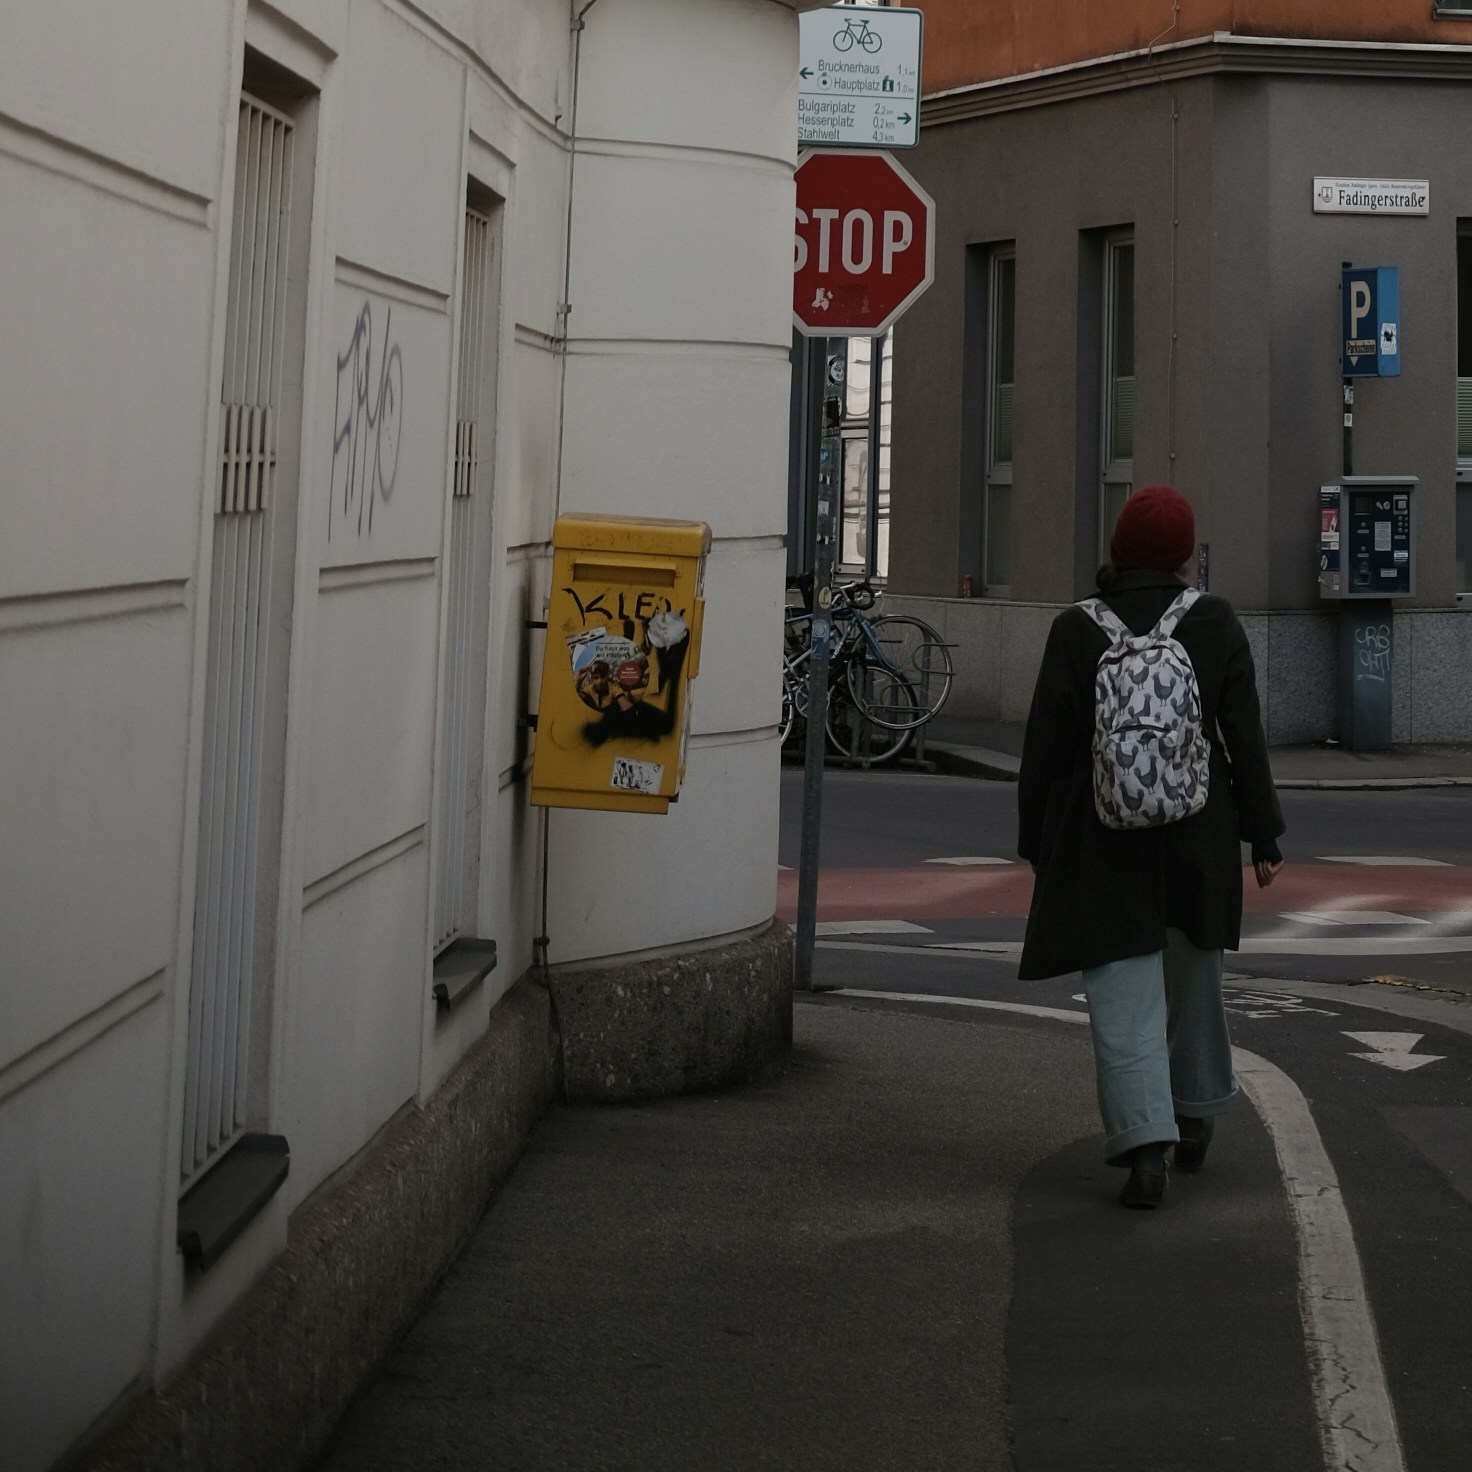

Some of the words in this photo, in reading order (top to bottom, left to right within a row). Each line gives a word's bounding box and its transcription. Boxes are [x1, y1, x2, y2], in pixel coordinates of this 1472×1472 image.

[818, 59, 880, 75] Brucknerhaus
[834, 77, 880, 92] Hauptplatz
[798, 99, 856, 114] Bulgariplatz
[797, 113, 854, 128] Hessenplatz
[873, 116, 885, 129] 0,2
[885, 119, 896, 128] km
[797, 126, 840, 140] Stahlwelt
[872, 130, 884, 142] 4,3
[884, 133, 895, 142] km
[1338, 189, 1426, 210] Fadingerstraße
[1351, 280, 1371, 338] P
